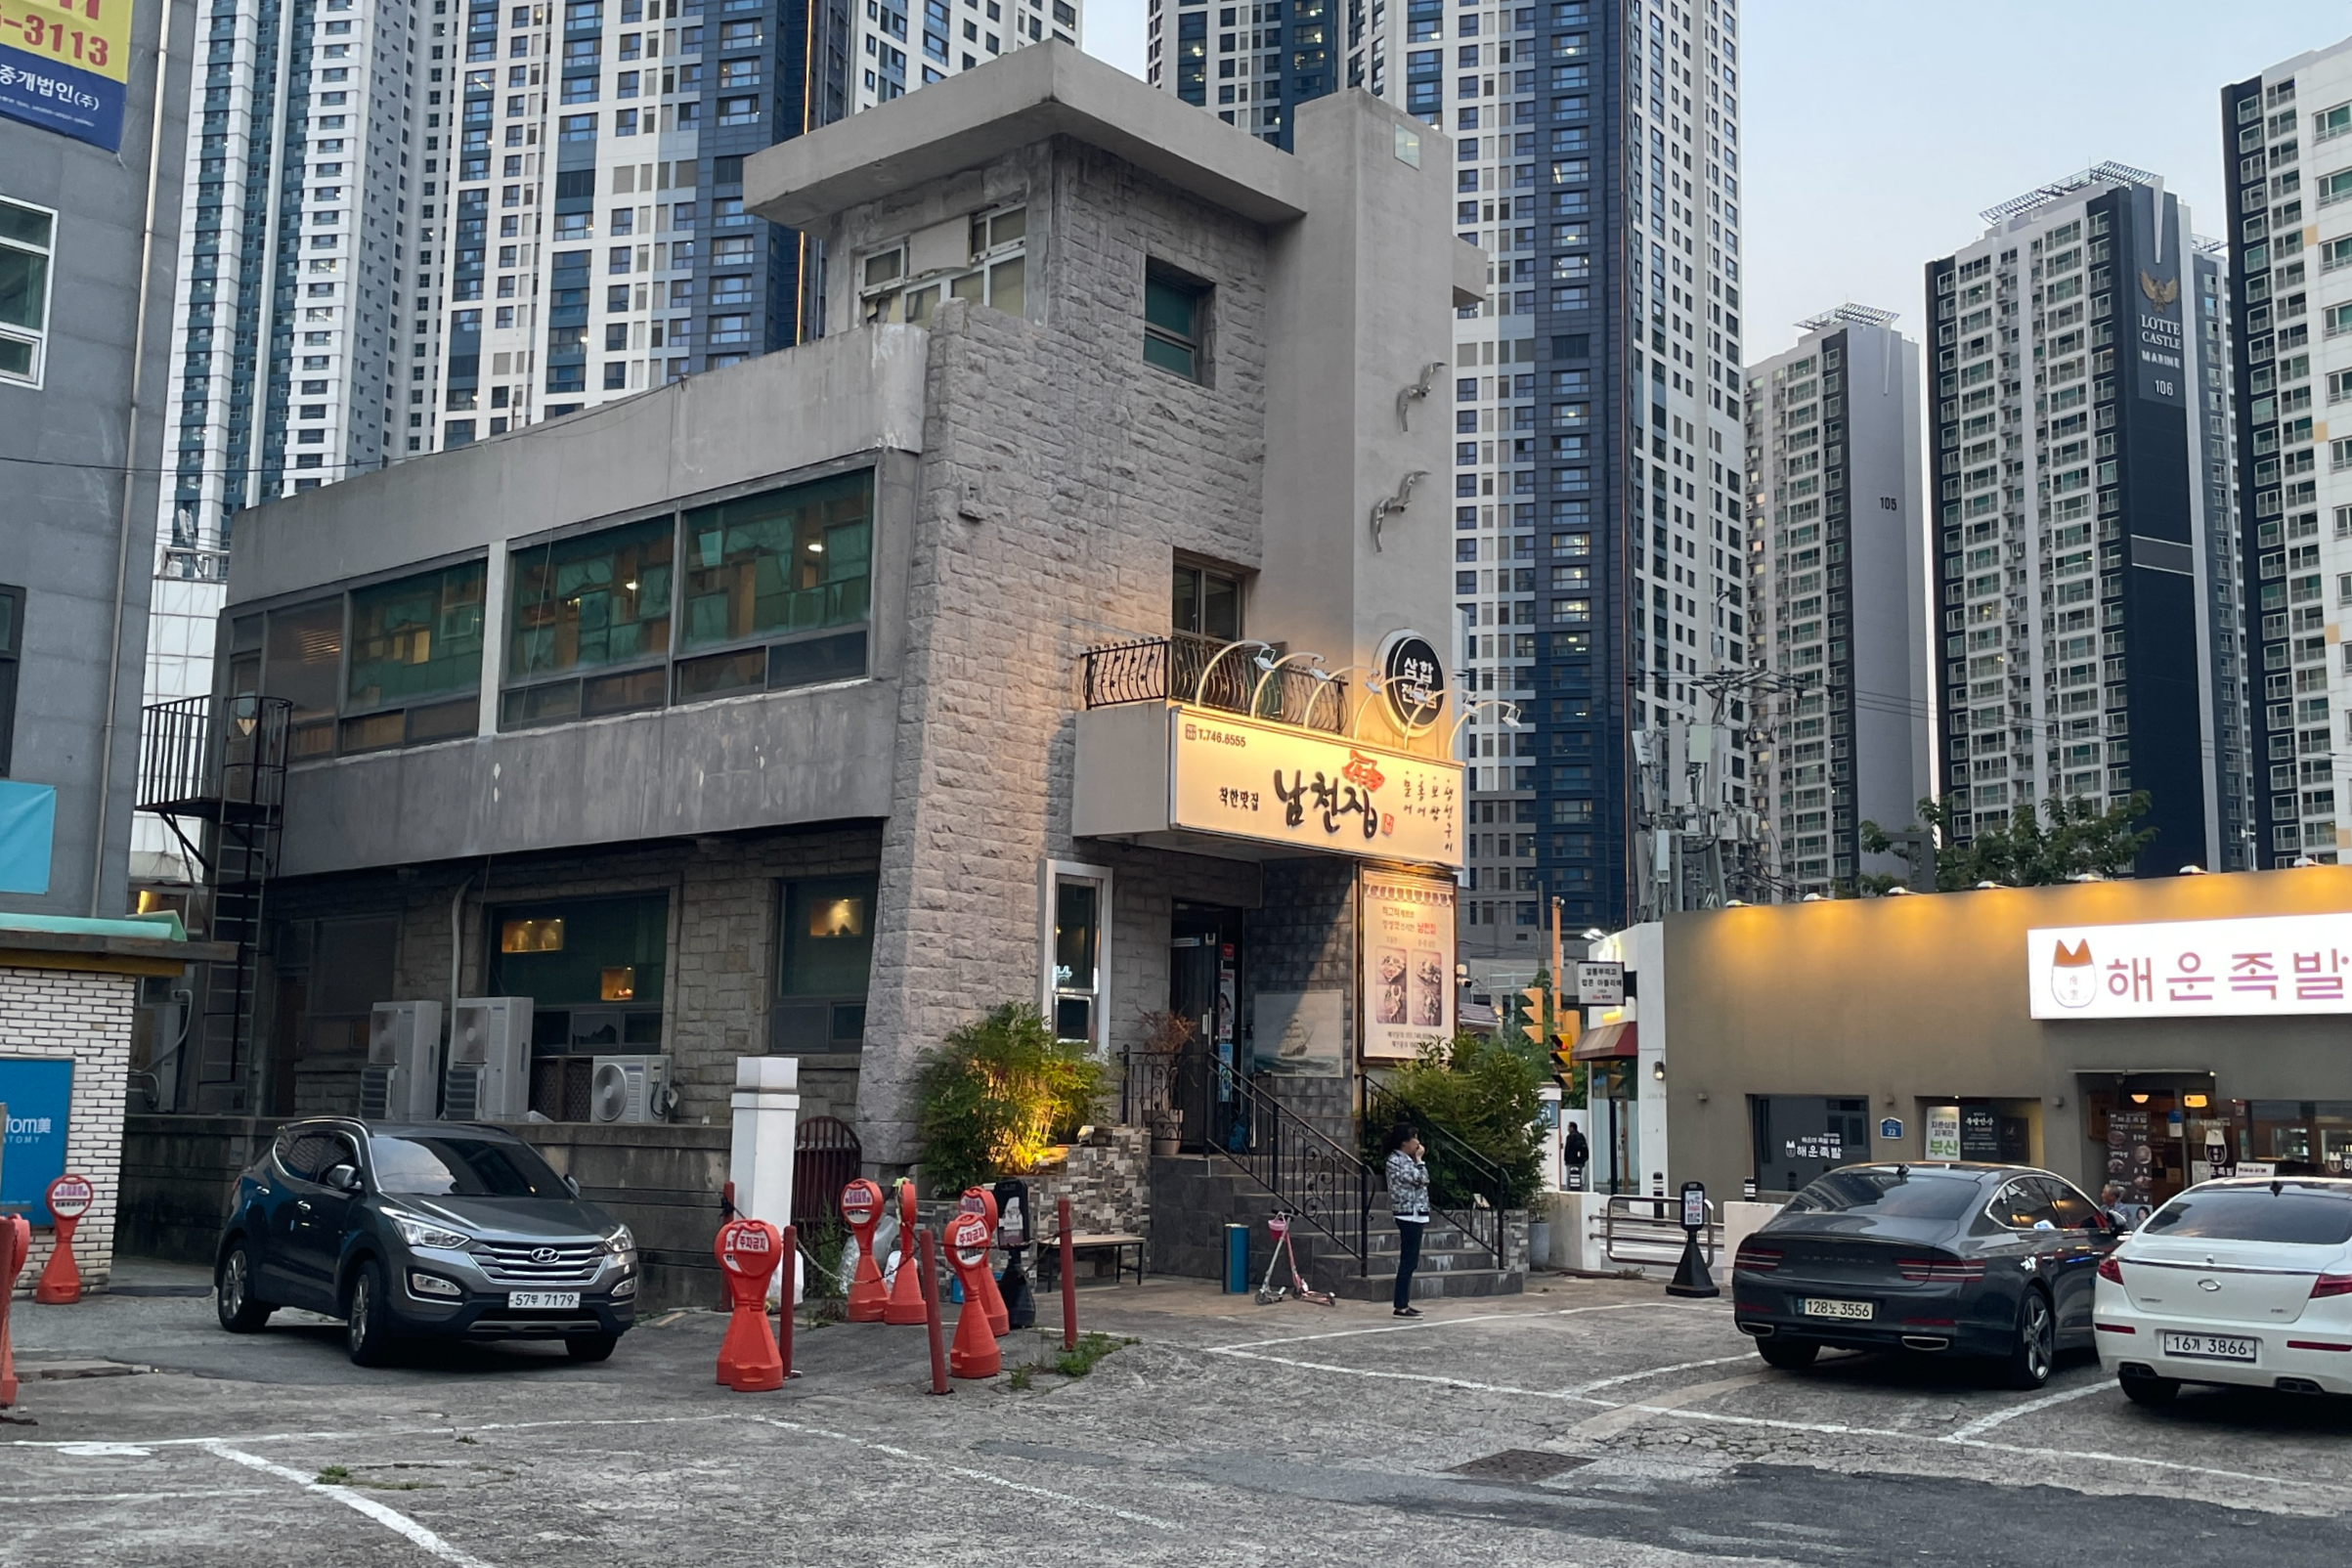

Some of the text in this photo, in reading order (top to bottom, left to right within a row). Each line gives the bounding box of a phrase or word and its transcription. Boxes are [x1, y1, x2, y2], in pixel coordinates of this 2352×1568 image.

[0, 13, 109, 66] -3113
[2141, 314, 2181, 335] LOTTE
[2141, 330, 2182, 350] CASTLE
[2141, 350, 2181, 369] MARINE
[2155, 379, 2174, 396] 106
[1880, 497, 1897, 511] 105
[1404, 657, 1434, 684] 삼합
[1401, 682, 1438, 710] 전점
[1198, 728, 1246, 748] T.746.6555
[1218, 787, 1259, 811] 착한맛집
[1274, 768, 1378, 840] 남천집
[1443, 786, 1454, 852] 생선구이
[2106, 948, 2350, 1002] 해운족발
[1797, 1145, 1842, 1159] 해운족발
[1930, 1140, 1959, 1156] 부산
[739, 1236, 766, 1250] 주차금지
[958, 1226, 985, 1246] 주차금지
[544, 1294, 575, 1306] 7179
[1807, 1300, 1870, 1318] 128노 3556
[2208, 1338, 2247, 1356] 3866
